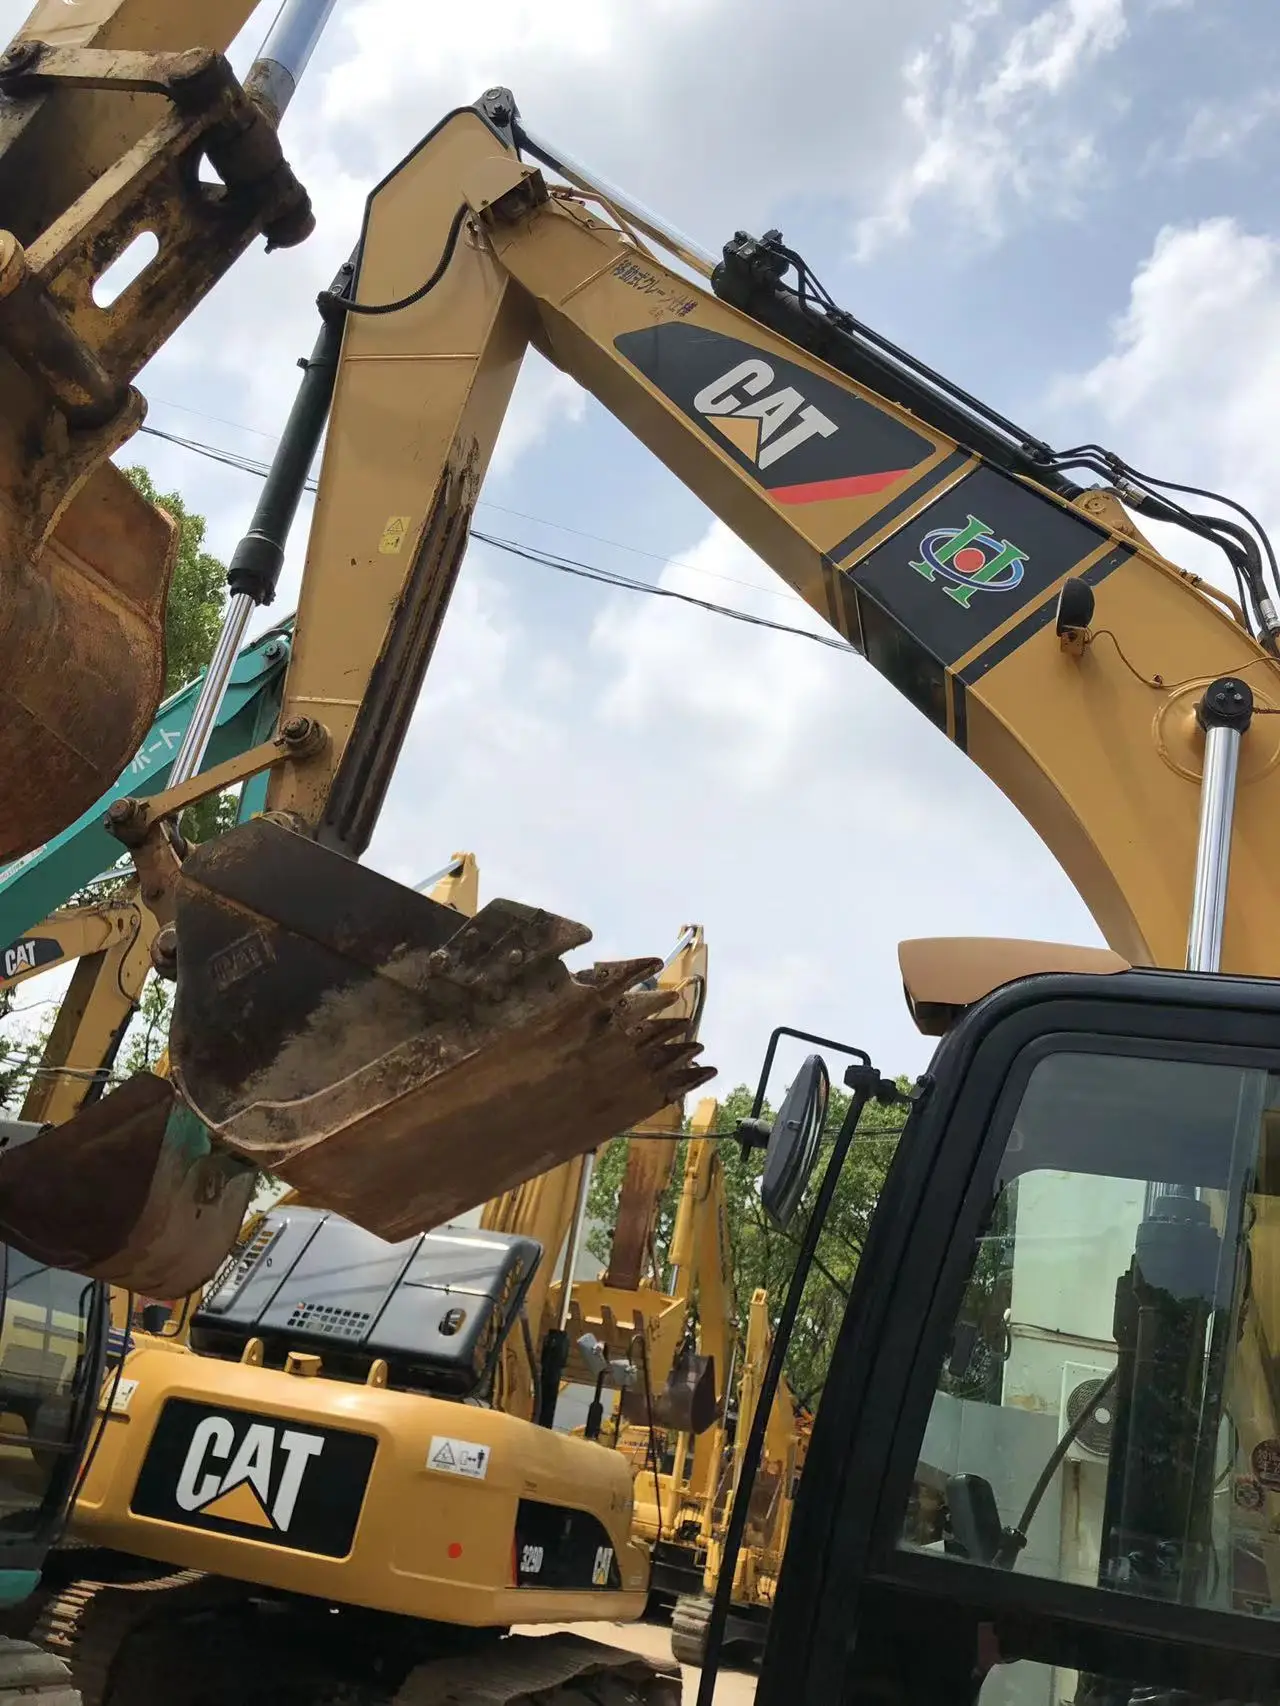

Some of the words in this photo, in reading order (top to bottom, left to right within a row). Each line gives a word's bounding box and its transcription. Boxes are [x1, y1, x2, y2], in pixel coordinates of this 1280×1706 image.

[694, 359, 839, 470] CAT
[5, 940, 36, 976] CAT
[176, 1416, 325, 1532] CAT
[592, 1546, 613, 1585] CAT
